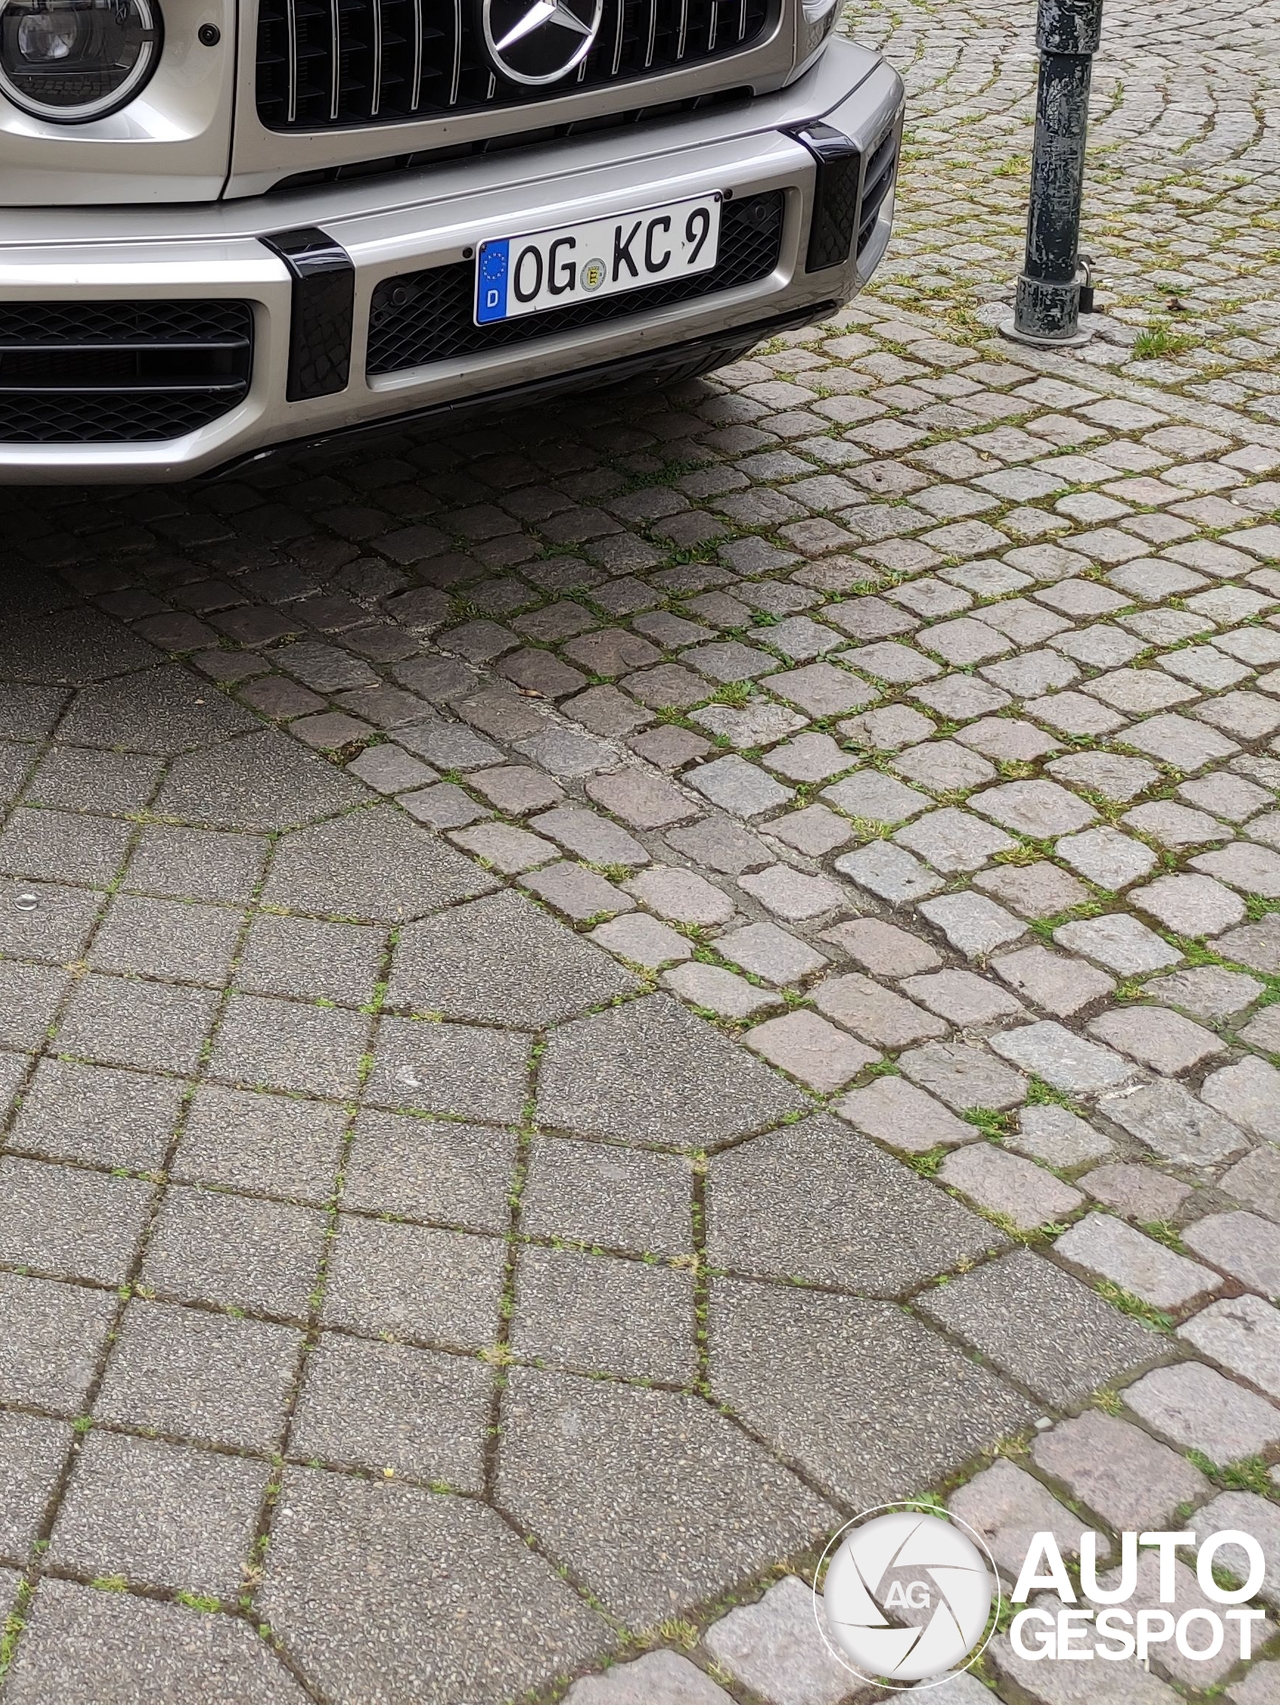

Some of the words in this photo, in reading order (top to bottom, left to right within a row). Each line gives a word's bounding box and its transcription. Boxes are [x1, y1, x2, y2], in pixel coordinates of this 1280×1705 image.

[486, 289, 499, 308] D
[513, 236, 577, 303] OG
[612, 215, 671, 282] KC
[685, 207, 710, 265] 9
